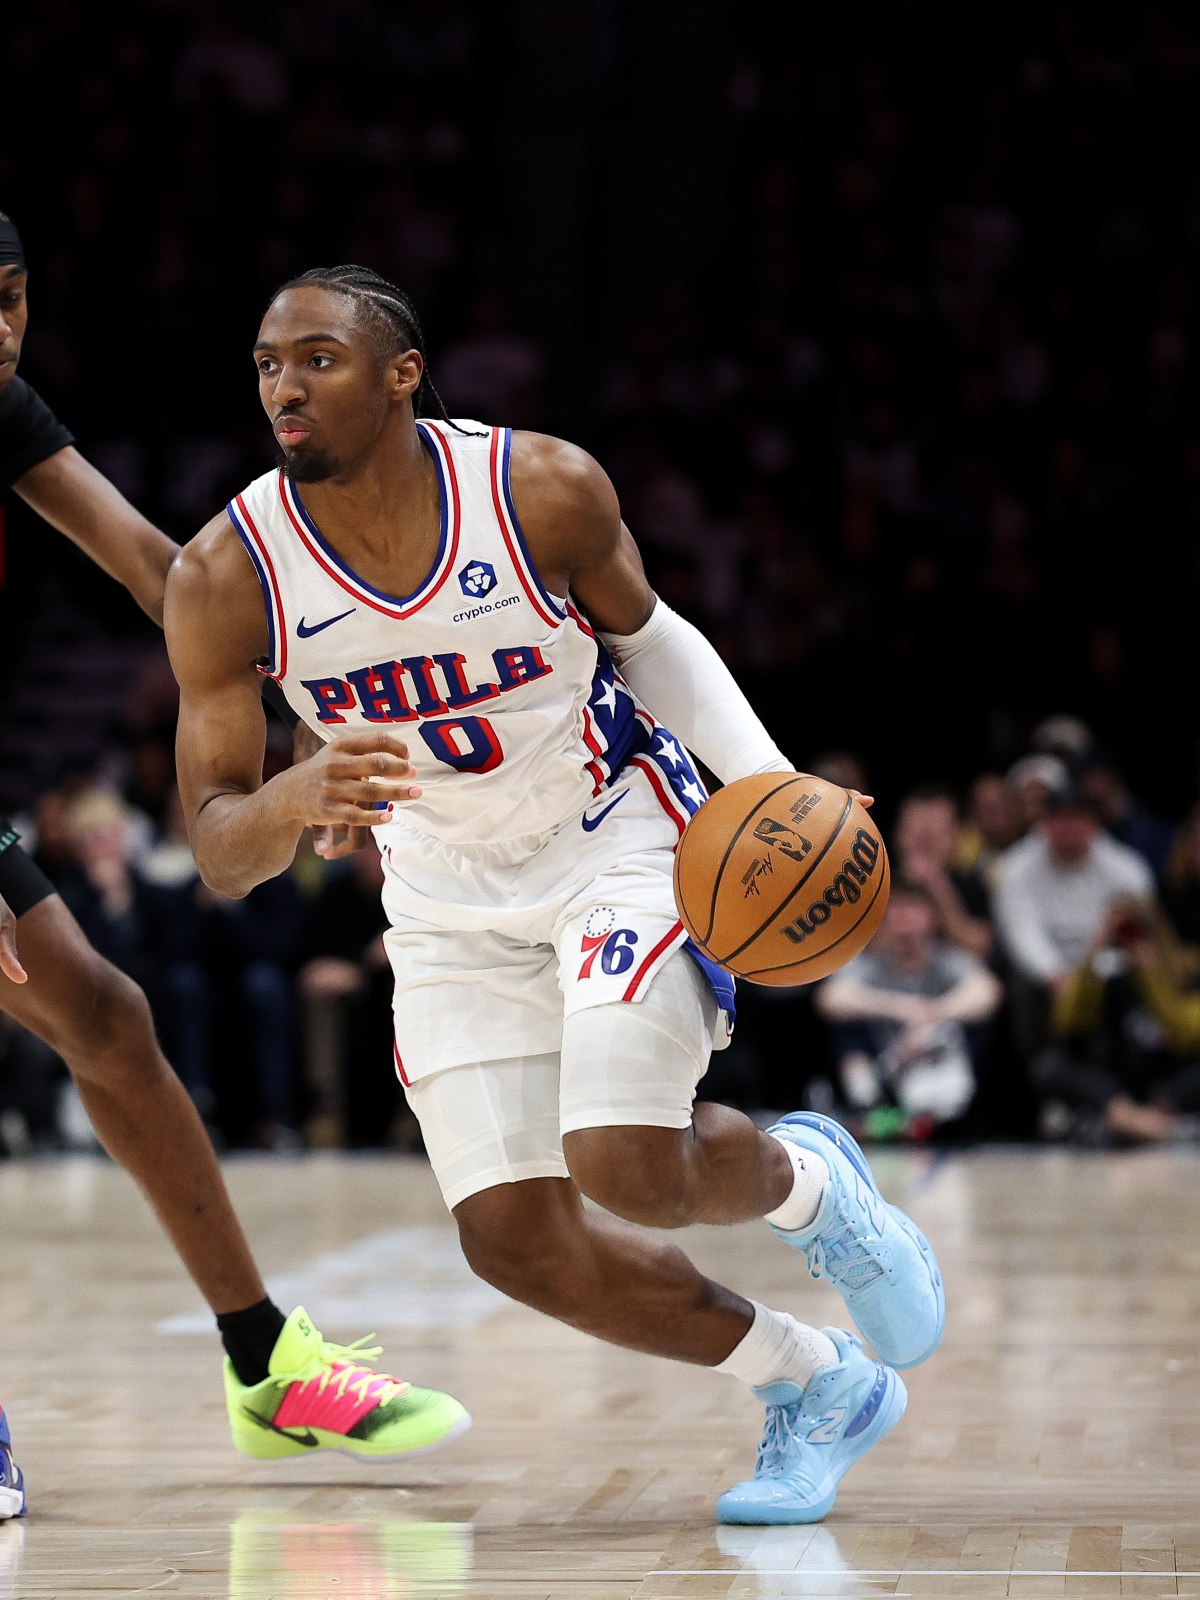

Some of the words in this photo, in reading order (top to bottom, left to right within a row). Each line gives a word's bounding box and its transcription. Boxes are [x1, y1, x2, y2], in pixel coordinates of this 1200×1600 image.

[452, 594, 521, 623] crypto.com
[300, 646, 553, 724] PHILA
[418, 716, 504, 774] 0
[779, 827, 879, 944] Wilson
[577, 928, 638, 982] 76
